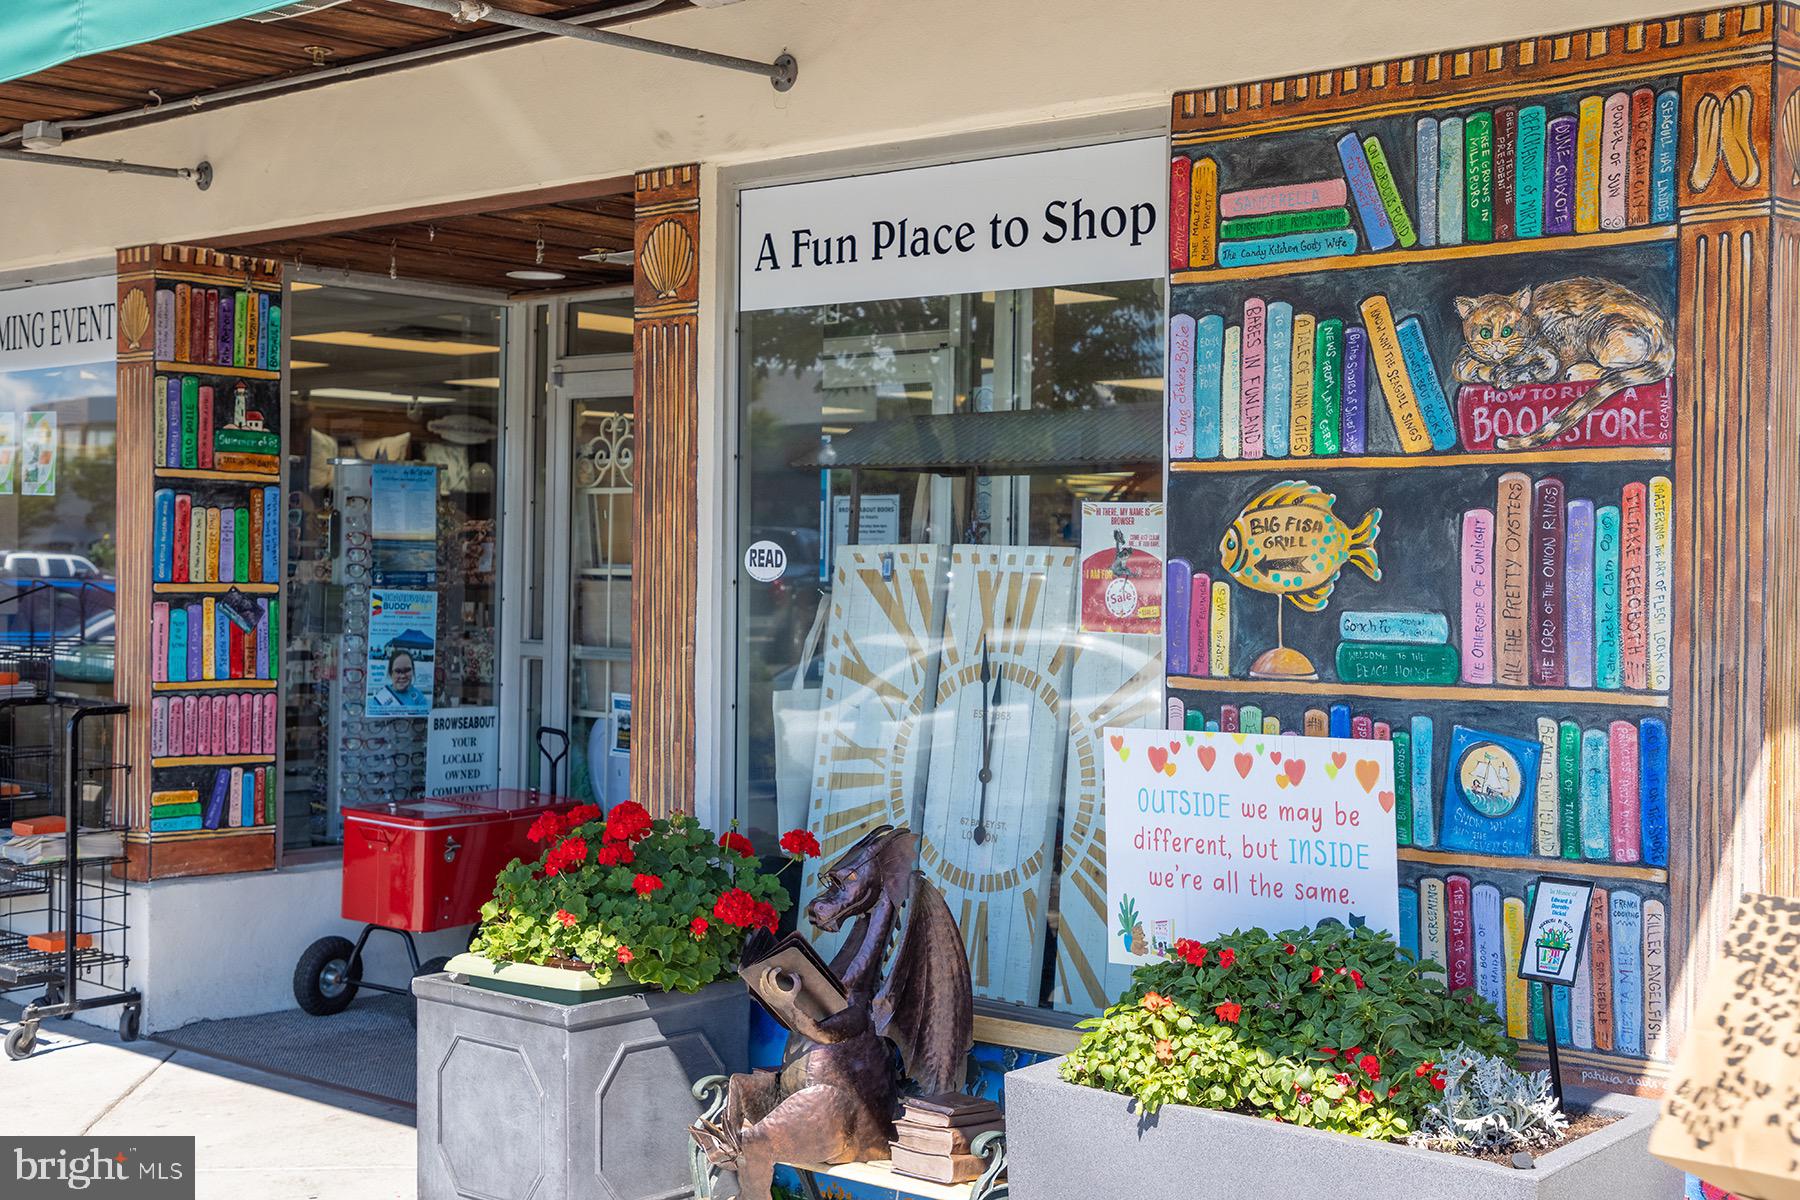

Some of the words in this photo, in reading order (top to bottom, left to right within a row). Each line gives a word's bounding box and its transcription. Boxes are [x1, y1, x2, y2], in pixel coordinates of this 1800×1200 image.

[1481, 120, 1488, 128] A
[1610, 105, 1624, 150] POWER
[1660, 100, 1674, 148] SEAGULL
[1481, 129, 1490, 157] TREE
[1506, 141, 1514, 155] WE
[1554, 125, 1570, 160] DUNE
[1496, 137, 1505, 190] PRESIDENT
[1610, 153, 1619, 166] OF
[1660, 153, 1670, 173] HAS
[1366, 143, 1379, 159] ON
[1389, 206, 1409, 237] POND
[1481, 161, 1490, 202] GROWS
[1554, 165, 1569, 225] QUIXOTE
[1607, 174, 1620, 198] SUN
[1633, 180, 1646, 208] CITY
[1657, 180, 1668, 219] LANDED
[1482, 209, 1489, 221] IN
[1520, 199, 1537, 234] MIRTH
[755, 233, 780, 271] A
[792, 229, 858, 268] Fun
[872, 218, 975, 260] Place
[989, 213, 1029, 249] to
[1042, 198, 1156, 246] Shop
[1172, 224, 1185, 262] NATIVE
[1201, 236, 1209, 261] MONK
[1223, 248, 1236, 260] The
[1241, 246, 1266, 259] Candy
[1269, 243, 1298, 257] Kitchen
[1326, 236, 1347, 249] Wife
[1245, 306, 1261, 348] BABES
[1298, 319, 1310, 327] A
[1369, 308, 1386, 332] KNOW
[1297, 330, 1310, 359] TALE
[1324, 327, 1337, 358] NEWS
[1376, 331, 1393, 353] WHY
[1408, 324, 1424, 352] RUINED
[1245, 354, 1261, 368] IN
[1297, 361, 1310, 374] OF
[1382, 351, 1396, 368] THE
[1322, 360, 1334, 388] FROM
[1295, 382, 1309, 410] TUNA
[1385, 368, 1411, 409] SEAGULL
[1483, 390, 1528, 404] HOW
[1530, 388, 1556, 400] TO
[1562, 387, 1591, 399] RU
[1623, 387, 1638, 401] A
[1243, 376, 1261, 445] FUNLAND
[1321, 390, 1333, 417] LAKE
[1294, 416, 1308, 453] CITIES
[1319, 419, 1336, 453] GERAR
[1400, 411, 1422, 443] SINGS
[185, 438, 194, 466] HELLO
[1111, 517, 1134, 525] BROWSER
[1129, 507, 1144, 515] NAME
[1505, 482, 1522, 552] OYSTERS
[1543, 487, 1558, 530] RINGS
[1654, 484, 1666, 540] MASTERING
[1250, 517, 1281, 536] BIG
[1285, 515, 1324, 534] FISH
[1625, 519, 1639, 557] TAKE
[1263, 536, 1307, 550] GRILL
[1470, 518, 1486, 575] SUNLIGHT
[1543, 537, 1556, 577] ONION
[749, 548, 783, 568] READ
[1656, 561, 1666, 577] ART
[1090, 569, 1101, 580] AM
[1101, 570, 1114, 580] FOR
[1603, 560, 1615, 596] Clam
[1655, 580, 1665, 592] OF
[1110, 593, 1133, 604] Sale
[1502, 558, 1522, 620] PRETTY
[1543, 582, 1554, 598] THE
[1216, 588, 1226, 621] WARS
[1543, 602, 1553, 614] OF
[1625, 565, 1643, 655] REHOBOTH
[1541, 620, 1556, 653] LORD
[1603, 603, 1615, 647] Jackie
[1503, 629, 1522, 654] THE
[1356, 664, 1388, 678] BEACH
[1502, 660, 1522, 682] ALL
[1541, 658, 1553, 680] THE
[1606, 653, 1615, 672] am
[1654, 631, 1667, 686] LOOKING
[433, 716, 496, 731] BROWSEABOUT
[451, 736, 478, 748] YOUR
[1539, 725, 1555, 765] BEACH
[442, 753, 485, 766] LOCALLY
[1395, 742, 1406, 782] AUGUST
[445, 769, 481, 780] OWNED
[960, 817, 969, 825] 67
[996, 822, 1007, 831] ST.
[1138, 787, 1230, 818] OUTSIDE
[1241, 802, 1268, 820] we
[1278, 803, 1324, 833] may
[1335, 801, 1360, 827] be
[962, 830, 998, 843] LOON
[1539, 809, 1555, 852] ISLAND
[1134, 826, 1233, 860] different,
[1242, 834, 1279, 861] but
[1289, 838, 1370, 870] INSIDE
[1148, 863, 1202, 891] we're
[1214, 870, 1239, 894] all
[1249, 872, 1284, 898] the
[1294, 881, 1356, 906] same.
[1454, 887, 1464, 905] THE
[1428, 884, 1439, 943] SCREENING
[1453, 910, 1464, 935] FISH
[1455, 940, 1464, 954] OF
[1647, 913, 1662, 958] KILLER
[1598, 982, 1607, 1024] NEEDLE
[1647, 963, 1661, 1040] ANGELFISH
